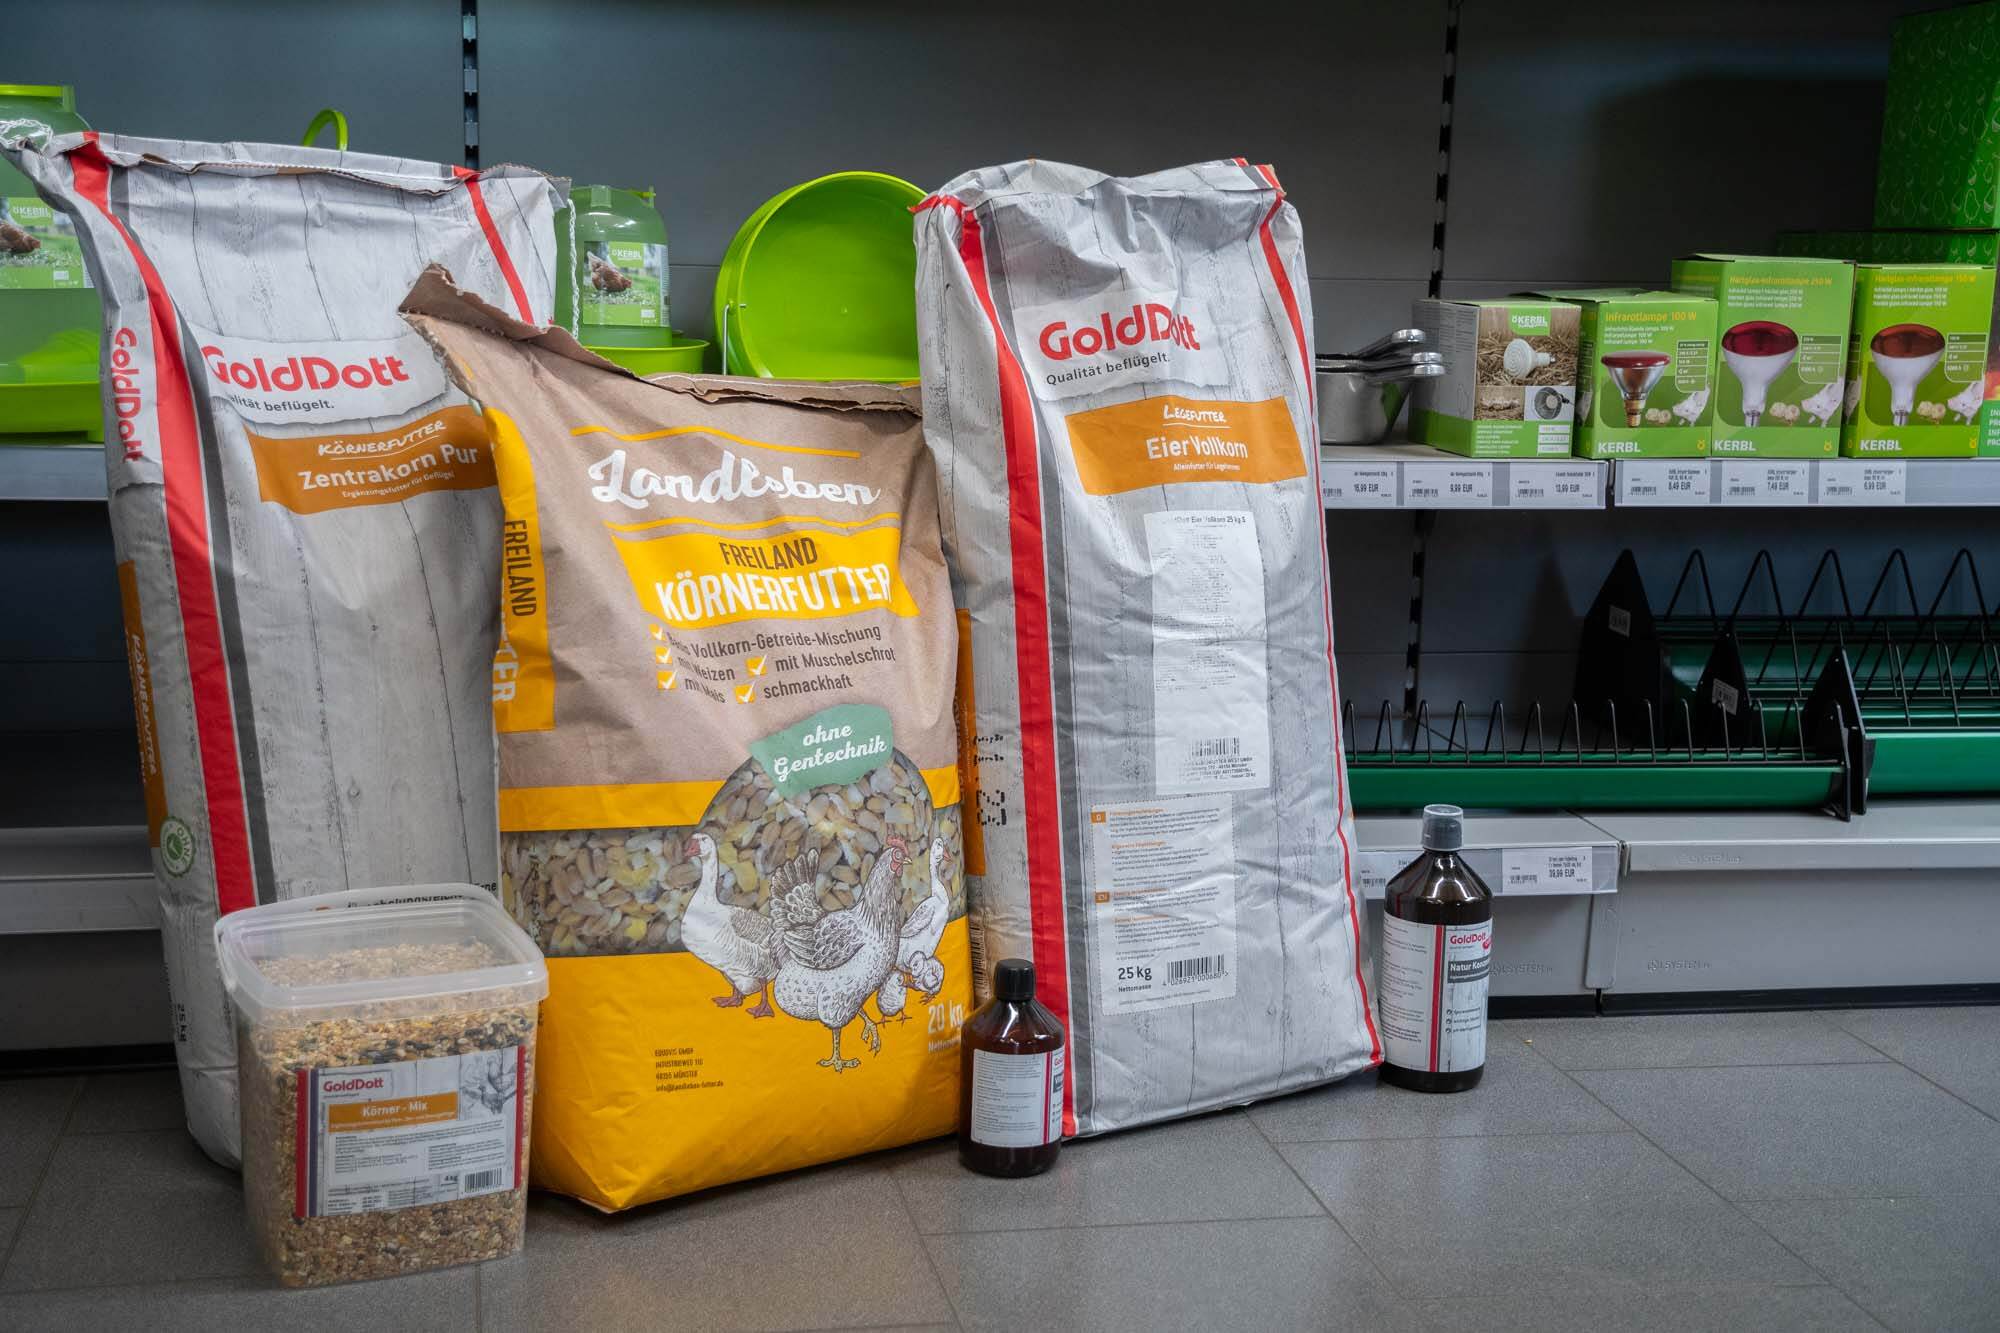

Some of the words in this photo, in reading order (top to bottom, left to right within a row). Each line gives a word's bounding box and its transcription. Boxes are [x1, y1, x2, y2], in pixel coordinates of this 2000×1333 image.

[1039, 303, 1200, 361] GoldDott
[201, 345, 410, 392] GoldDott
[1046, 364, 1102, 387] Qualität
[1106, 351, 1171, 373] beflügelt.
[111, 327, 144, 463] GoldDott
[264, 399, 335, 413] beflügelt.
[317, 420, 448, 457] KÖRNERFUTTER
[1146, 436, 1189, 460] Eier
[1189, 434, 1248, 459] Vollkorn
[1598, 441, 1641, 453] KERBL
[1713, 440, 1757, 452] KERBL
[1860, 439, 1903, 451] KERBL
[297, 452, 437, 490] Zentrakorn
[439, 443, 477, 465] Pur
[1368, 483, 1379, 493] EUR
[1462, 483, 1473, 493] EUR
[1569, 483, 1580, 493] EUR
[1680, 481, 1691, 491] EUR
[1779, 481, 1789, 491] EUR
[718, 536, 819, 571] FREILAND
[503, 519, 537, 618] FREILAND
[654, 563, 891, 623] KÖRNERFUTTER
[691, 625, 882, 659] Vollkorn-Getreide-Mischung
[775, 655, 800, 673] mit
[803, 646, 896, 669] Muschelschrot
[763, 674, 854, 699] schmackhaft
[802, 719, 853, 747] ohne
[773, 735, 889, 783] Gentechnik
[1564, 868, 1575, 878] EUR
[1450, 933, 1486, 945] GoldDott
[1118, 967, 1134, 980] 25
[1136, 966, 1152, 981] kg
[1450, 963, 1472, 972] Natur
[927, 1003, 945, 1034] 20
[323, 1077, 385, 1093] GoldDott
[362, 1105, 401, 1118] Körner
[409, 1102, 428, 1112] Mix
